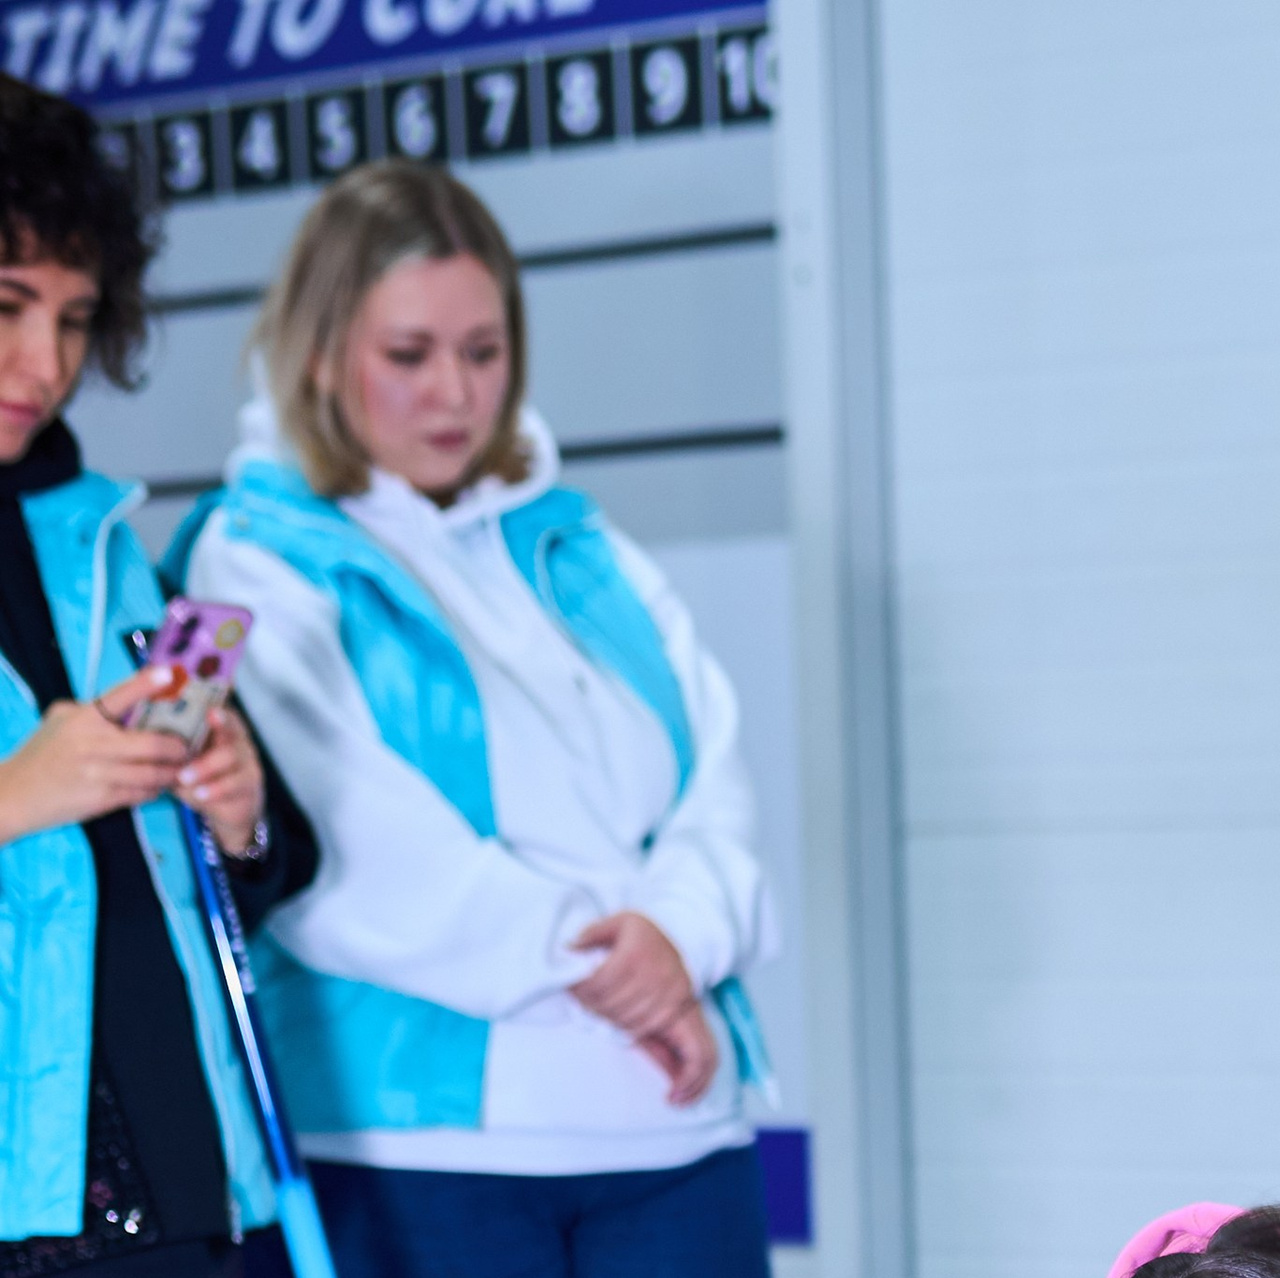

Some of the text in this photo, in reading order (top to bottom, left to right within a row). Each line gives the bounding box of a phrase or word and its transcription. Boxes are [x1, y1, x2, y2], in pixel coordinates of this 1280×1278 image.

[5, 0, 208, 93] TIME
[163, 119, 203, 191] 3
[237, 108, 281, 180] 4
[313, 98, 358, 170] 5
[393, 82, 437, 158] 6
[472, 71, 517, 148] 7
[556, 59, 602, 137] 8
[642, 45, 690, 127] 9
